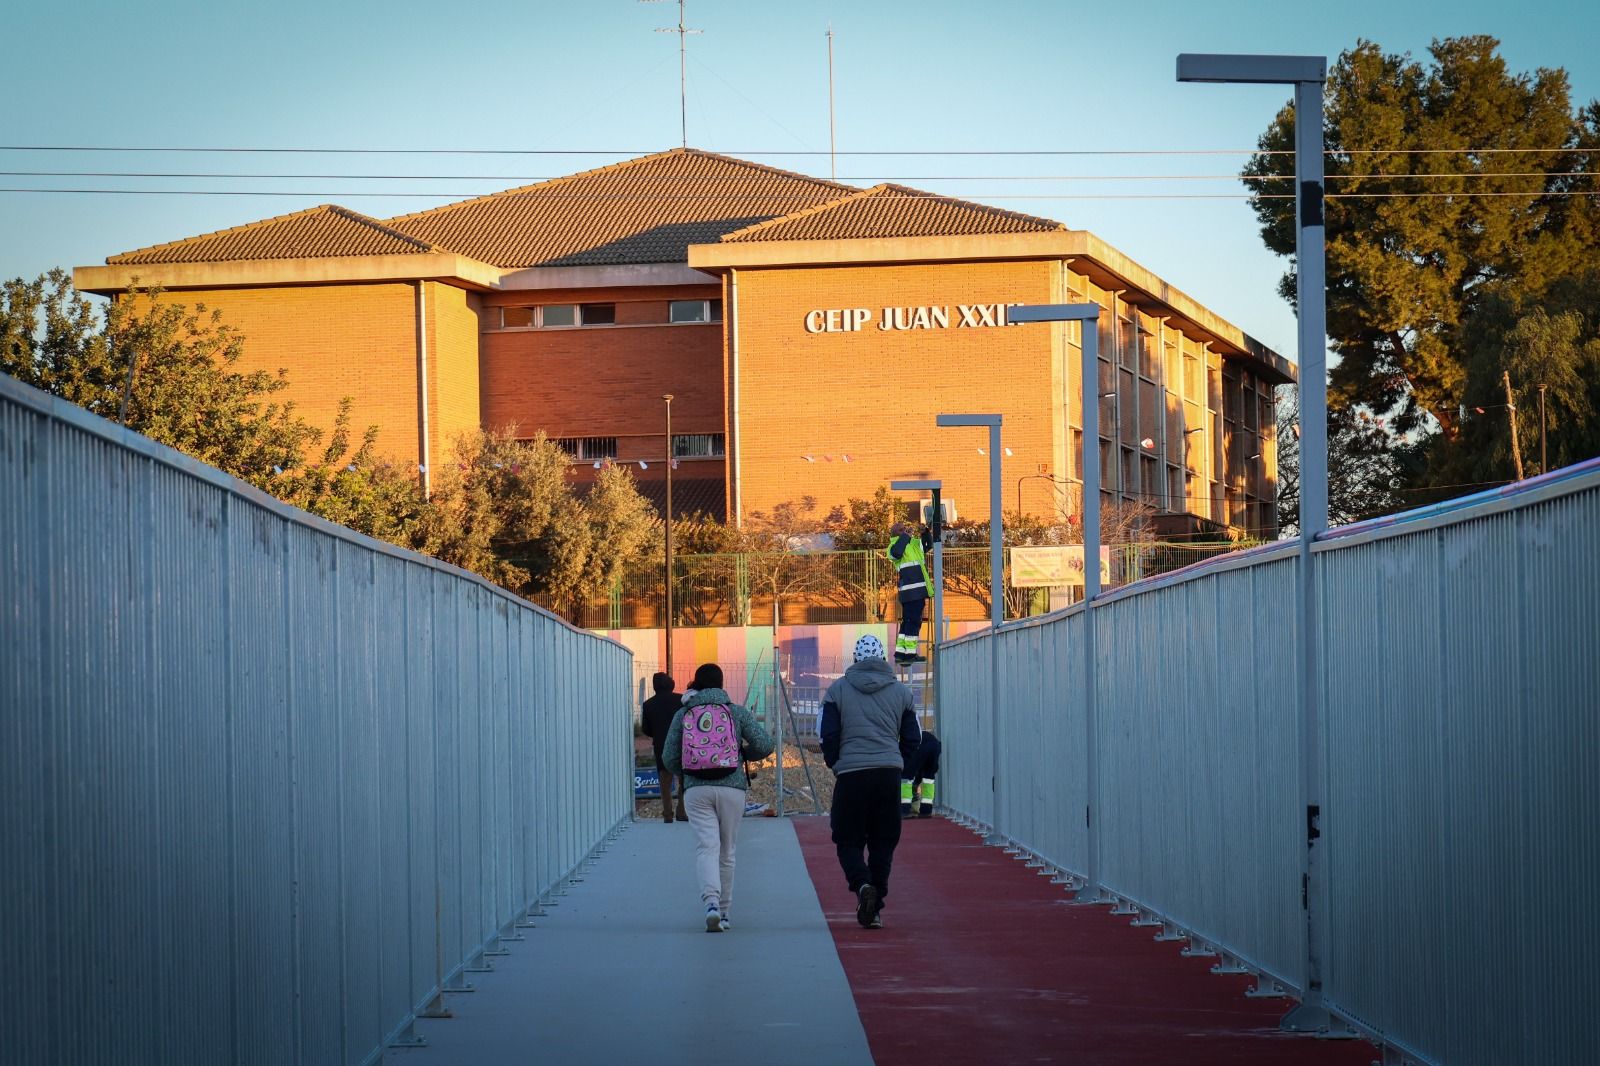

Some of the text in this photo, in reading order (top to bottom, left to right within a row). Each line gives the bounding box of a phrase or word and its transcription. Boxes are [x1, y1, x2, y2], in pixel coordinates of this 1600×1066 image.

[805, 303, 1025, 333] CEIP JUAN XXI
